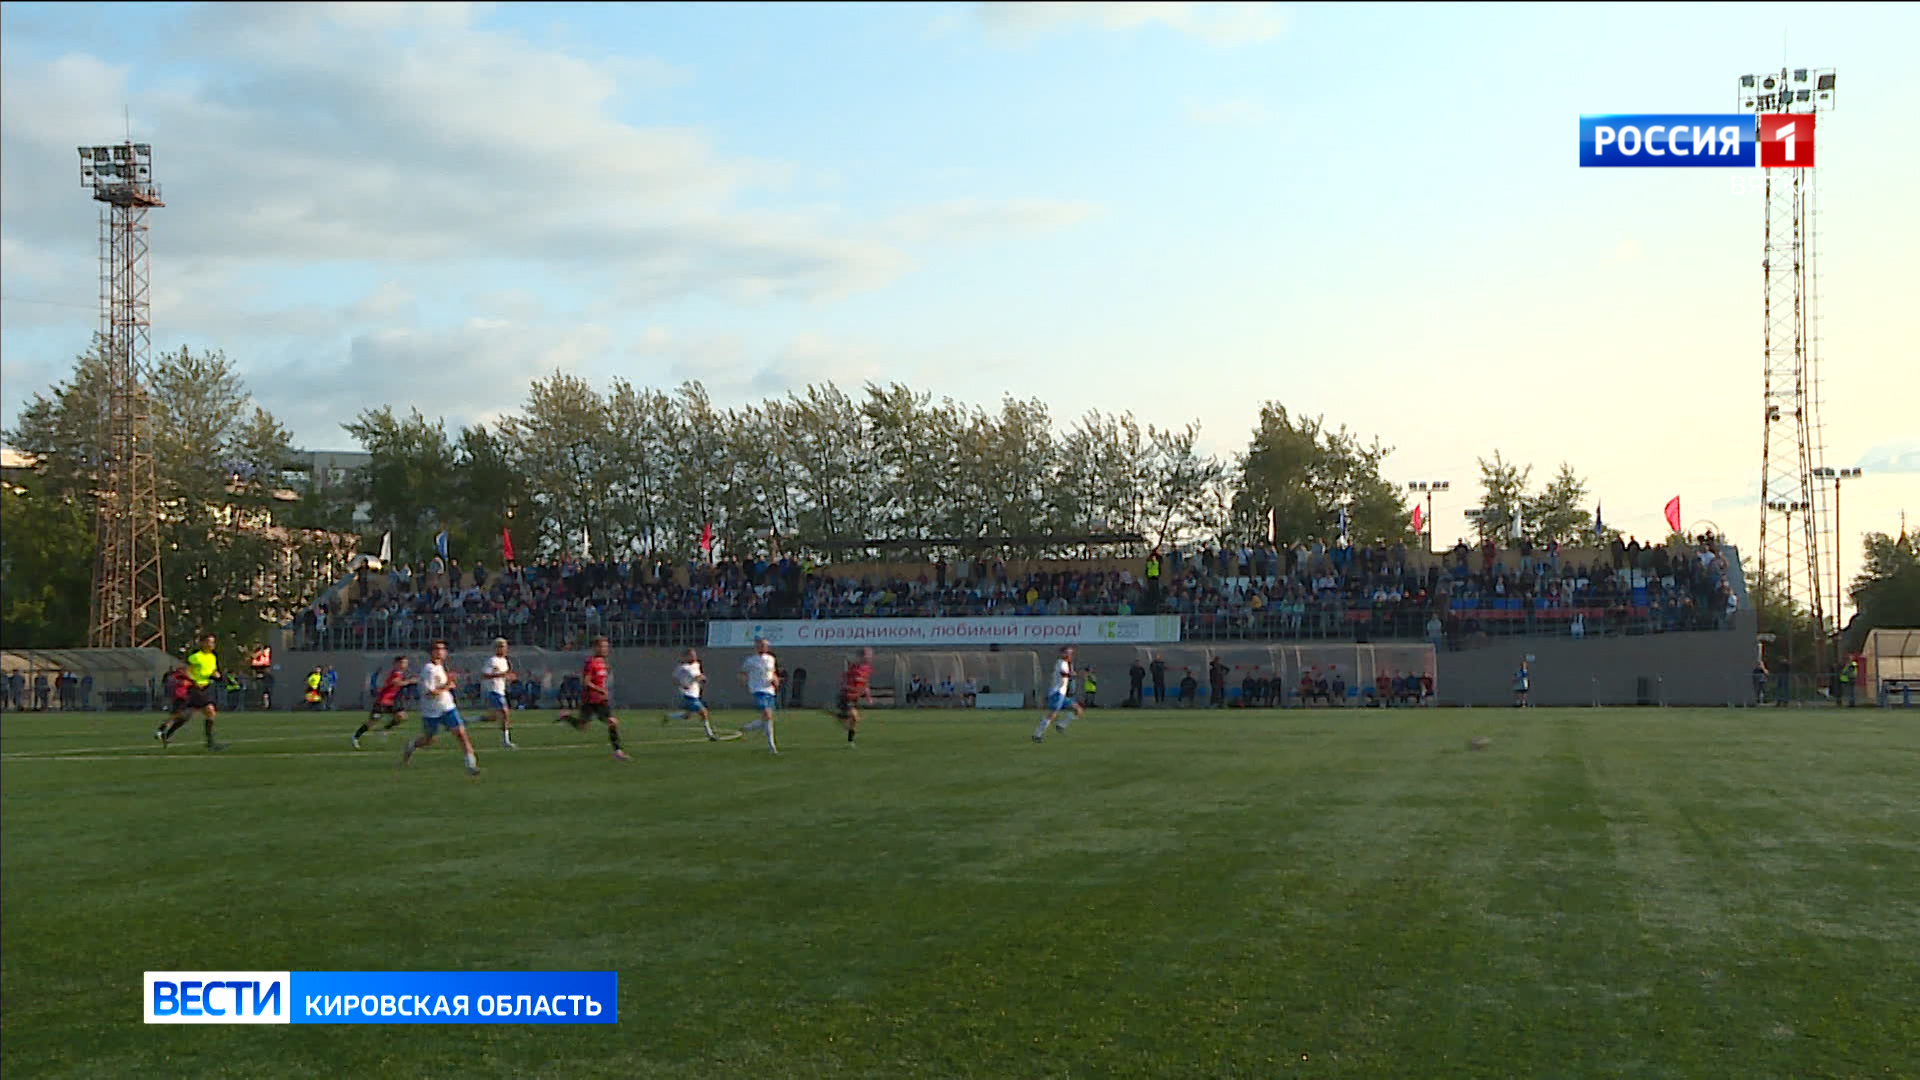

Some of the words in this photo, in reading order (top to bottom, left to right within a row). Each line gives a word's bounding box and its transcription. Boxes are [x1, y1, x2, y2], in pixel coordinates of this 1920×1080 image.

[797, 625, 810, 640] С
[814, 624, 926, 641] праздником,
[930, 621, 1018, 637] любимый
[1023, 621, 1083, 638] город!
